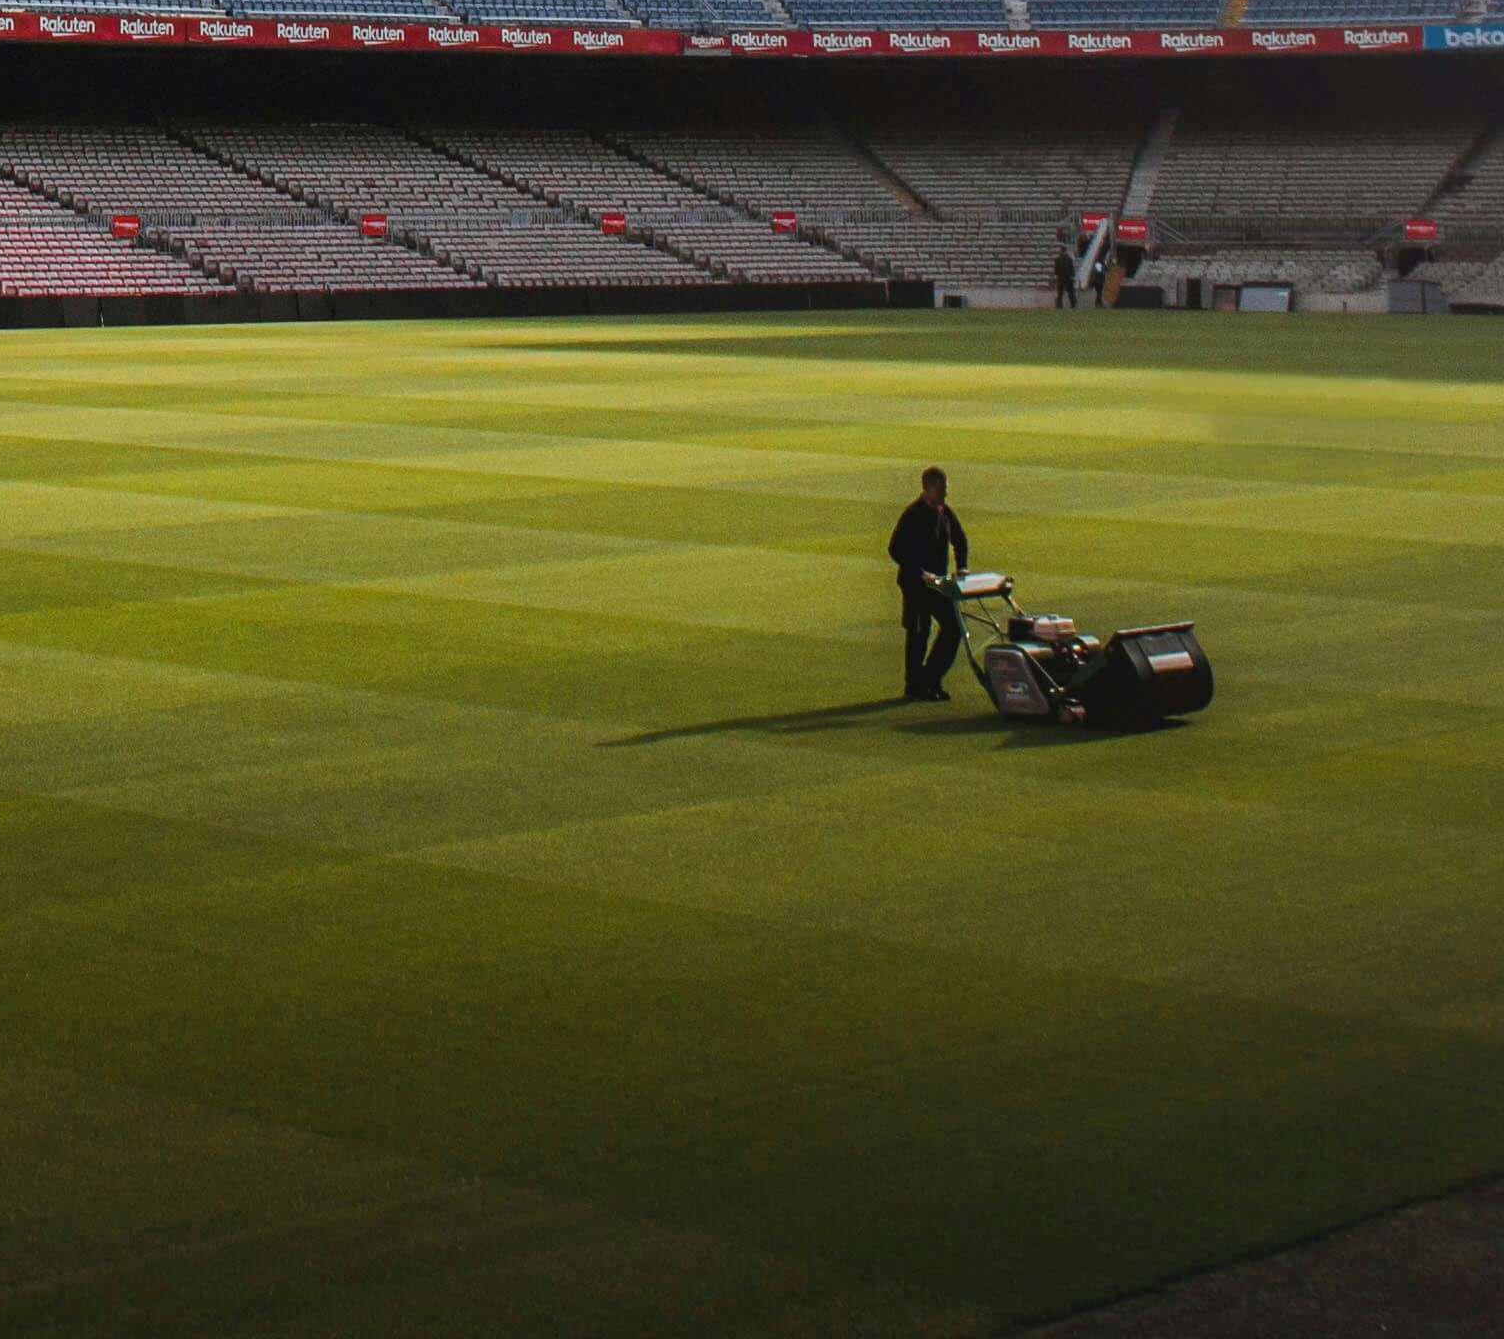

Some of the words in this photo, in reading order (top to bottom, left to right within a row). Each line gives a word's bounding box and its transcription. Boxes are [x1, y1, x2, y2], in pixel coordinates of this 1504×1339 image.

[40, 16, 95, 34] Rakuten
[120, 19, 174, 36] Rakuten
[200, 21, 253, 38] Rakuten
[277, 23, 329, 40] Rakuten
[352, 25, 405, 42] Rakuten
[428, 27, 479, 44] Rakuten
[501, 29, 551, 46] Rakuten
[573, 30, 623, 47] Rakuten
[732, 32, 787, 49] Rakuten
[813, 33, 871, 50] Rakuten
[890, 33, 950, 49] Rakuten
[978, 33, 1040, 49] Rakuten
[1068, 33, 1131, 50] Rakuten
[1161, 32, 1224, 49] Rakuten
[1252, 30, 1315, 47] Rakuten
[1344, 28, 1408, 45] Rakuten
